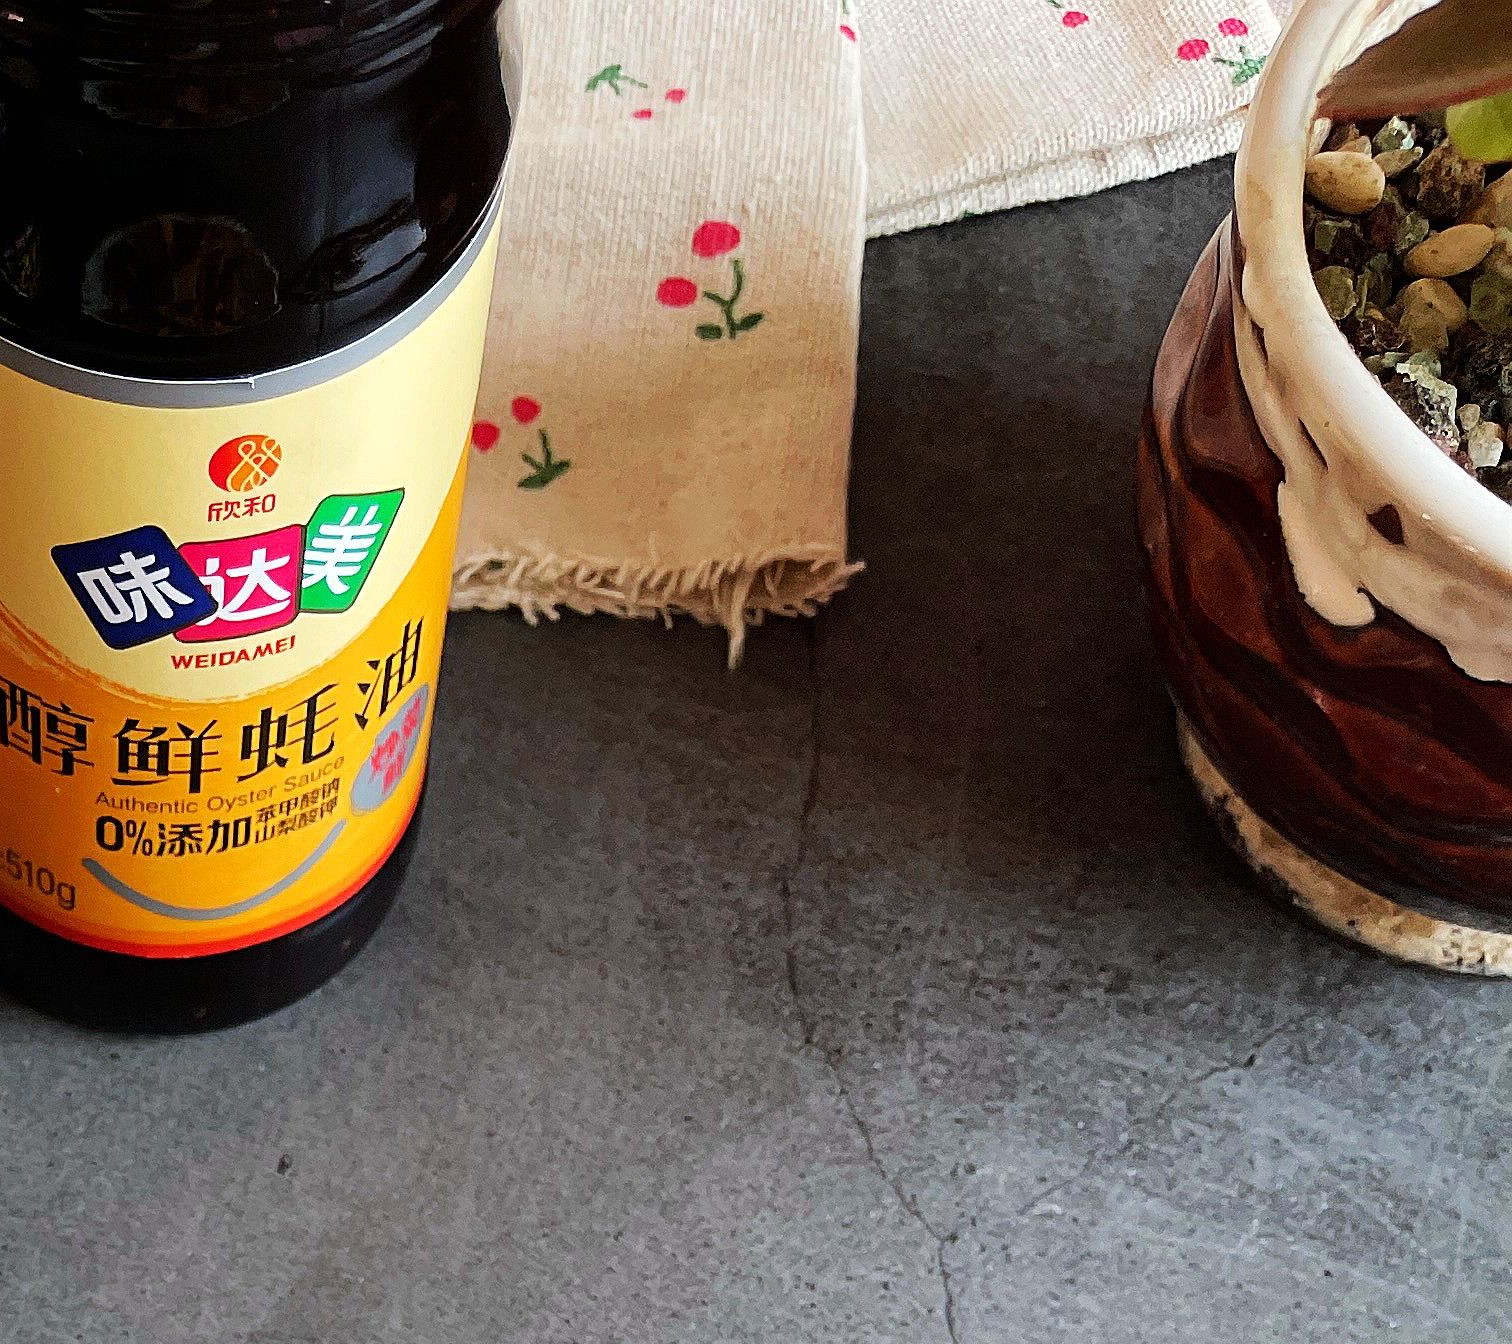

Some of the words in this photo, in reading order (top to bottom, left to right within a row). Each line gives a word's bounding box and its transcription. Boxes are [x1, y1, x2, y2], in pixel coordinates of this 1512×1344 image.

[207, 493, 276, 522] 欣和
[76, 505, 385, 625] 味达美
[170, 635, 296, 670] WEIDAMEI
[95, 791, 199, 816] Authentic
[207, 785, 277, 813] Oyster
[95, 815, 252, 858] 0%添加
